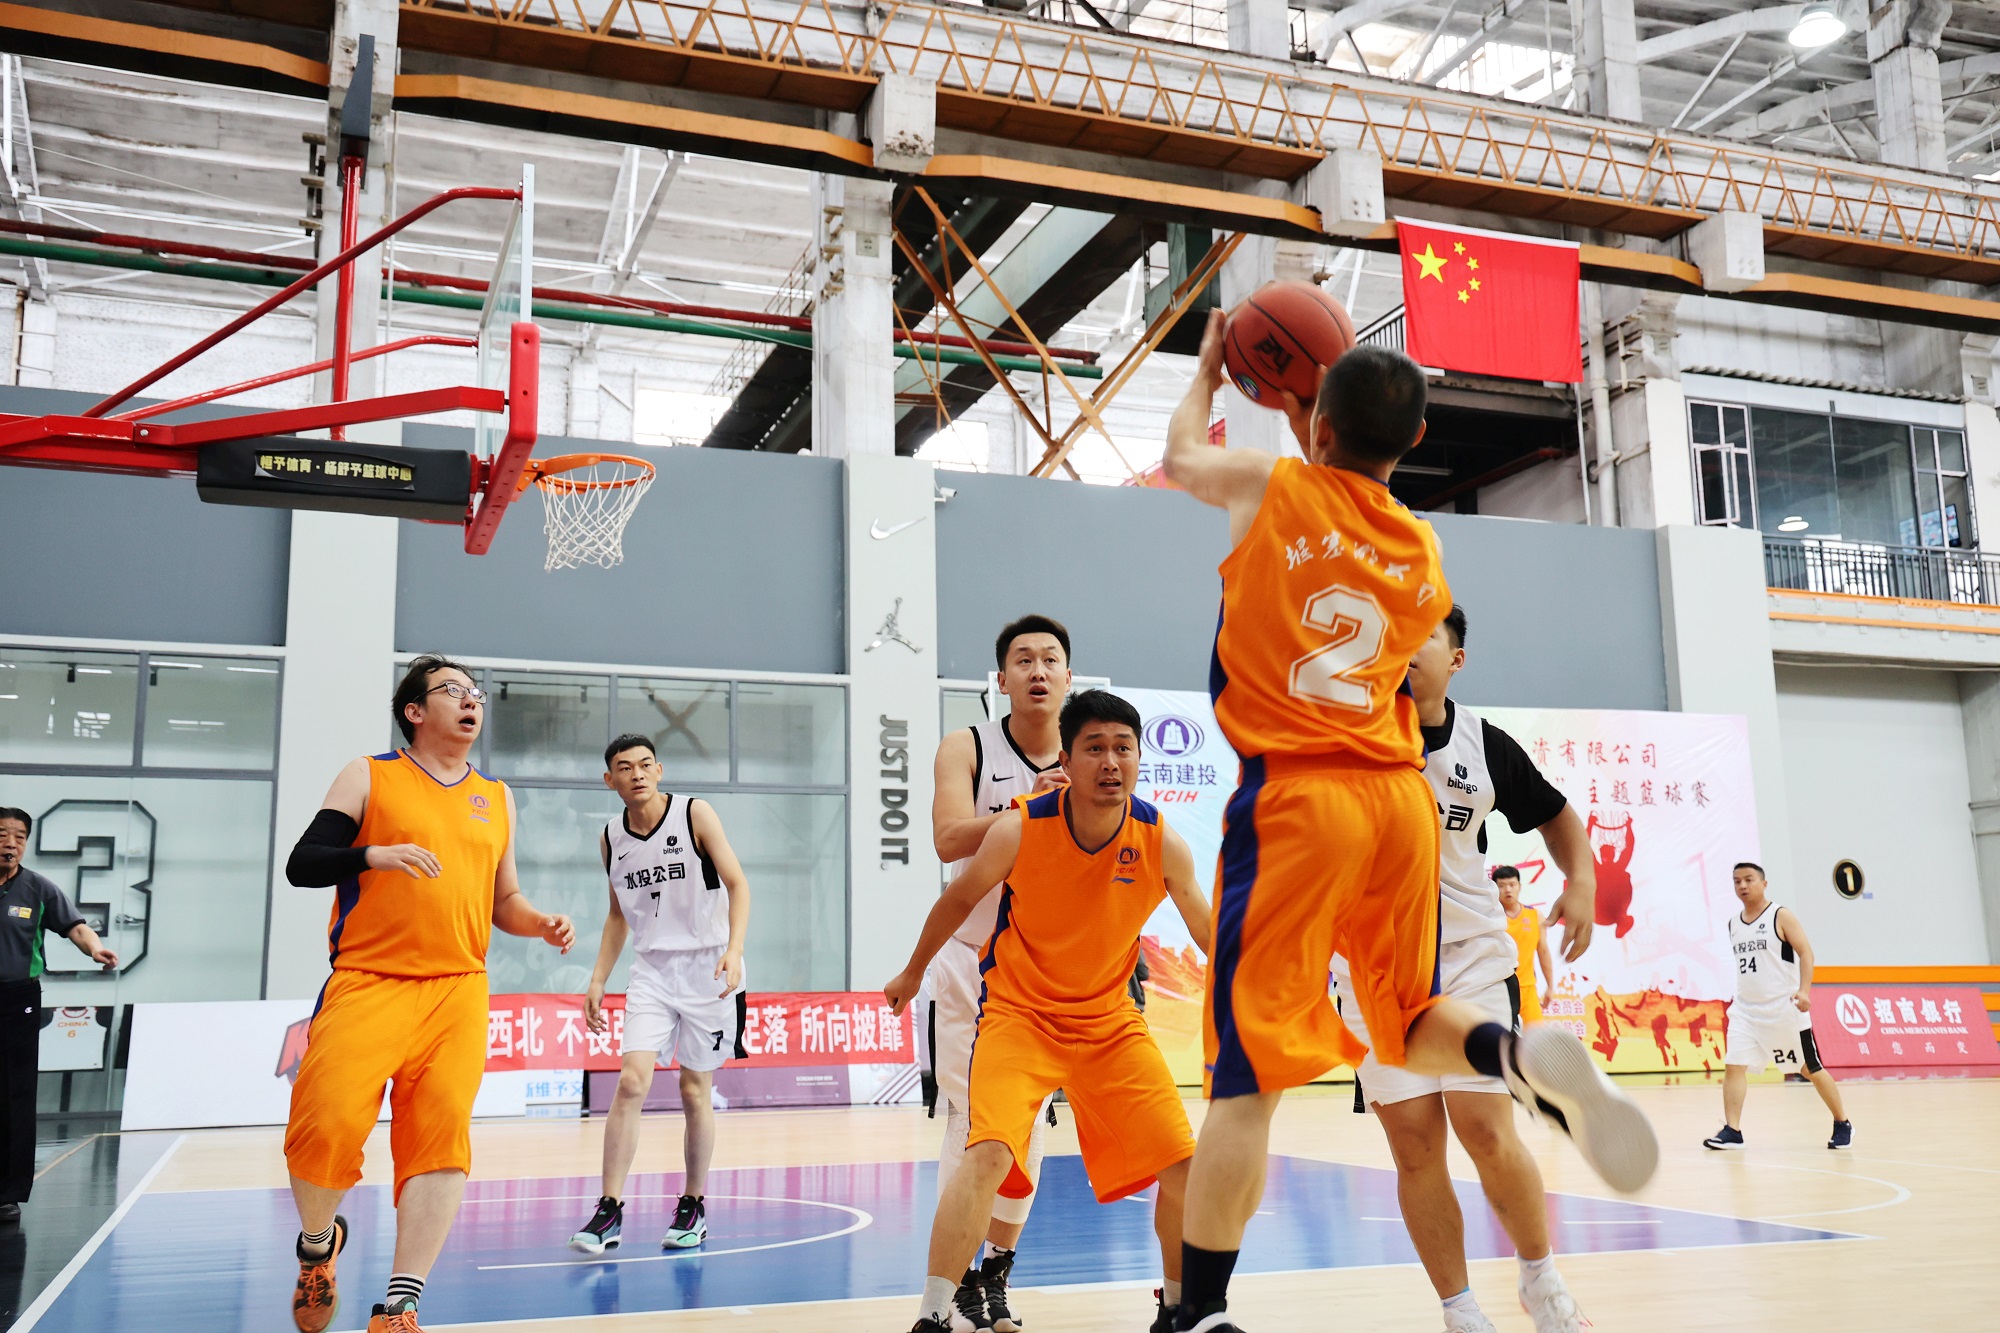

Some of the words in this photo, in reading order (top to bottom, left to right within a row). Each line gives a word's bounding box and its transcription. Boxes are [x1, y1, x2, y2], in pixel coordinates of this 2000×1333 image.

[1288, 583, 1389, 714] 2
[880, 715, 908, 783] JUST
[1137, 763, 1217, 786] 云南建投
[1447, 777, 1478, 794] bibigo
[1153, 790, 1199, 803] YCIH
[880, 789, 909, 832] DO
[663, 847, 683, 855] bibigo
[881, 838, 909, 865] IT
[624, 862, 686, 889] 水投公司
[1843, 867, 1855, 891] 1
[650, 891, 661, 917] 7
[1739, 957, 1757, 973] 24
[1873, 997, 1962, 1024] 招商银行
[67, 1029, 76, 1038] 6
[713, 1030, 724, 1051] 7
[1773, 1049, 1797, 1064] 24
